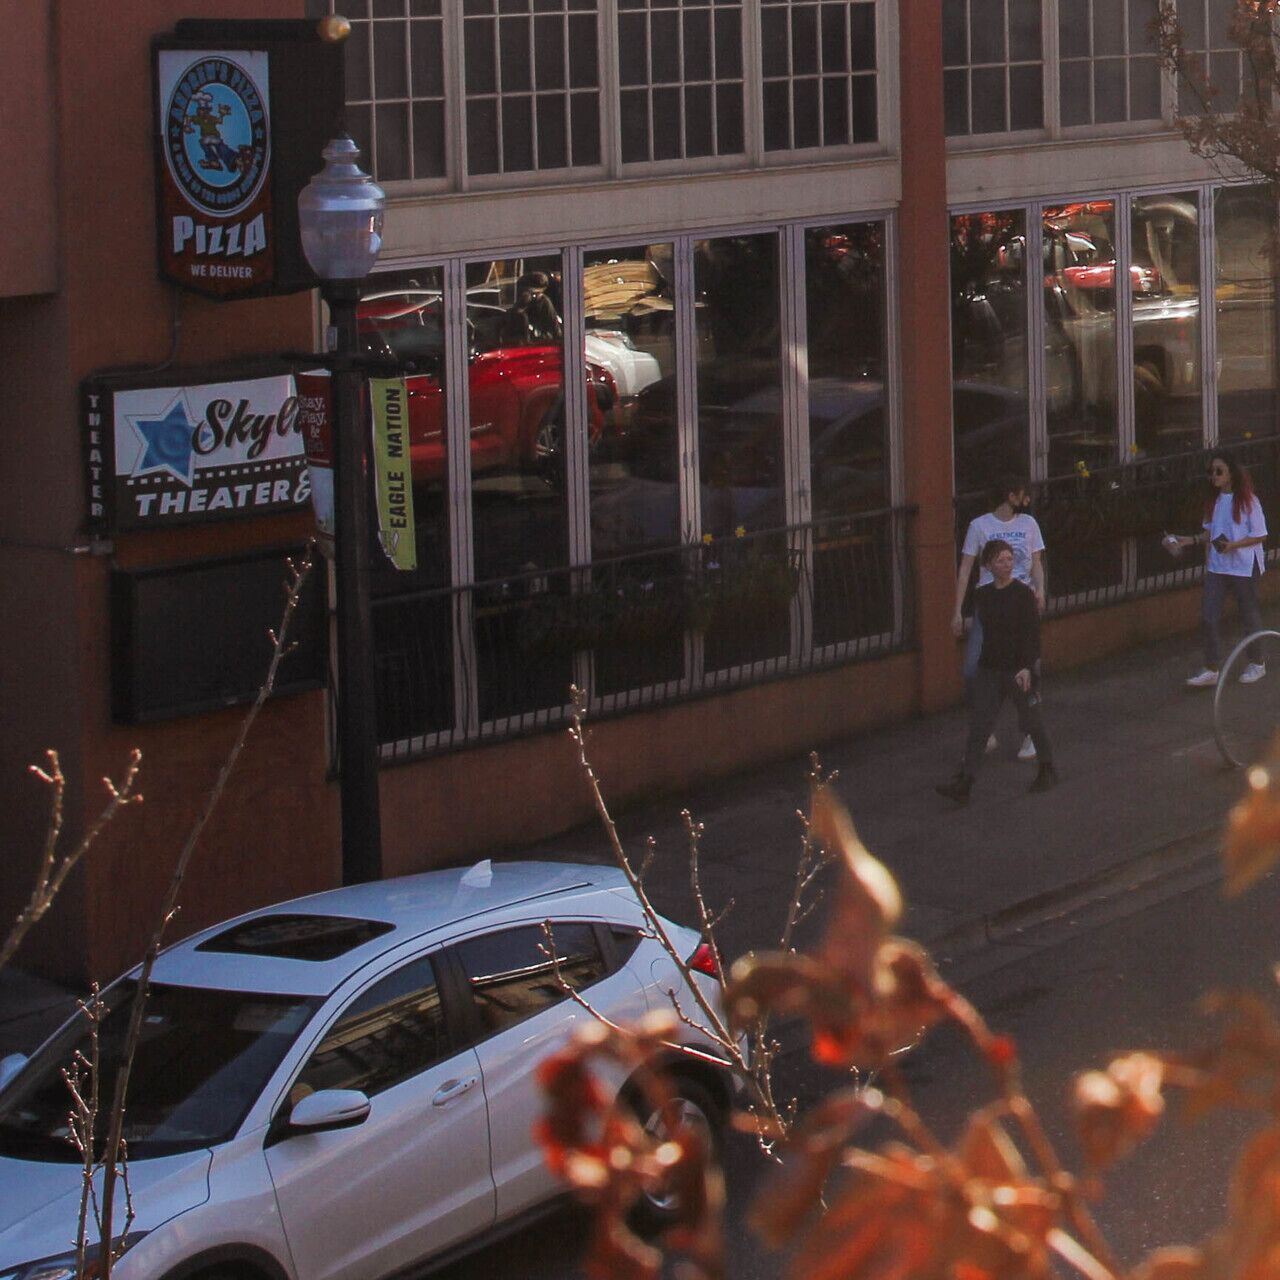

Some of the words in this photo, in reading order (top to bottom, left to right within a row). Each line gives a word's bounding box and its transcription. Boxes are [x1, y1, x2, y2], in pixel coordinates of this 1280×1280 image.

[190, 263, 207, 277] WE
[209, 264, 252, 279] DELIVER
[385, 387, 403, 459] NATION
[135, 479, 290, 518] THEATER
[389, 470, 408, 530] EAGLE
